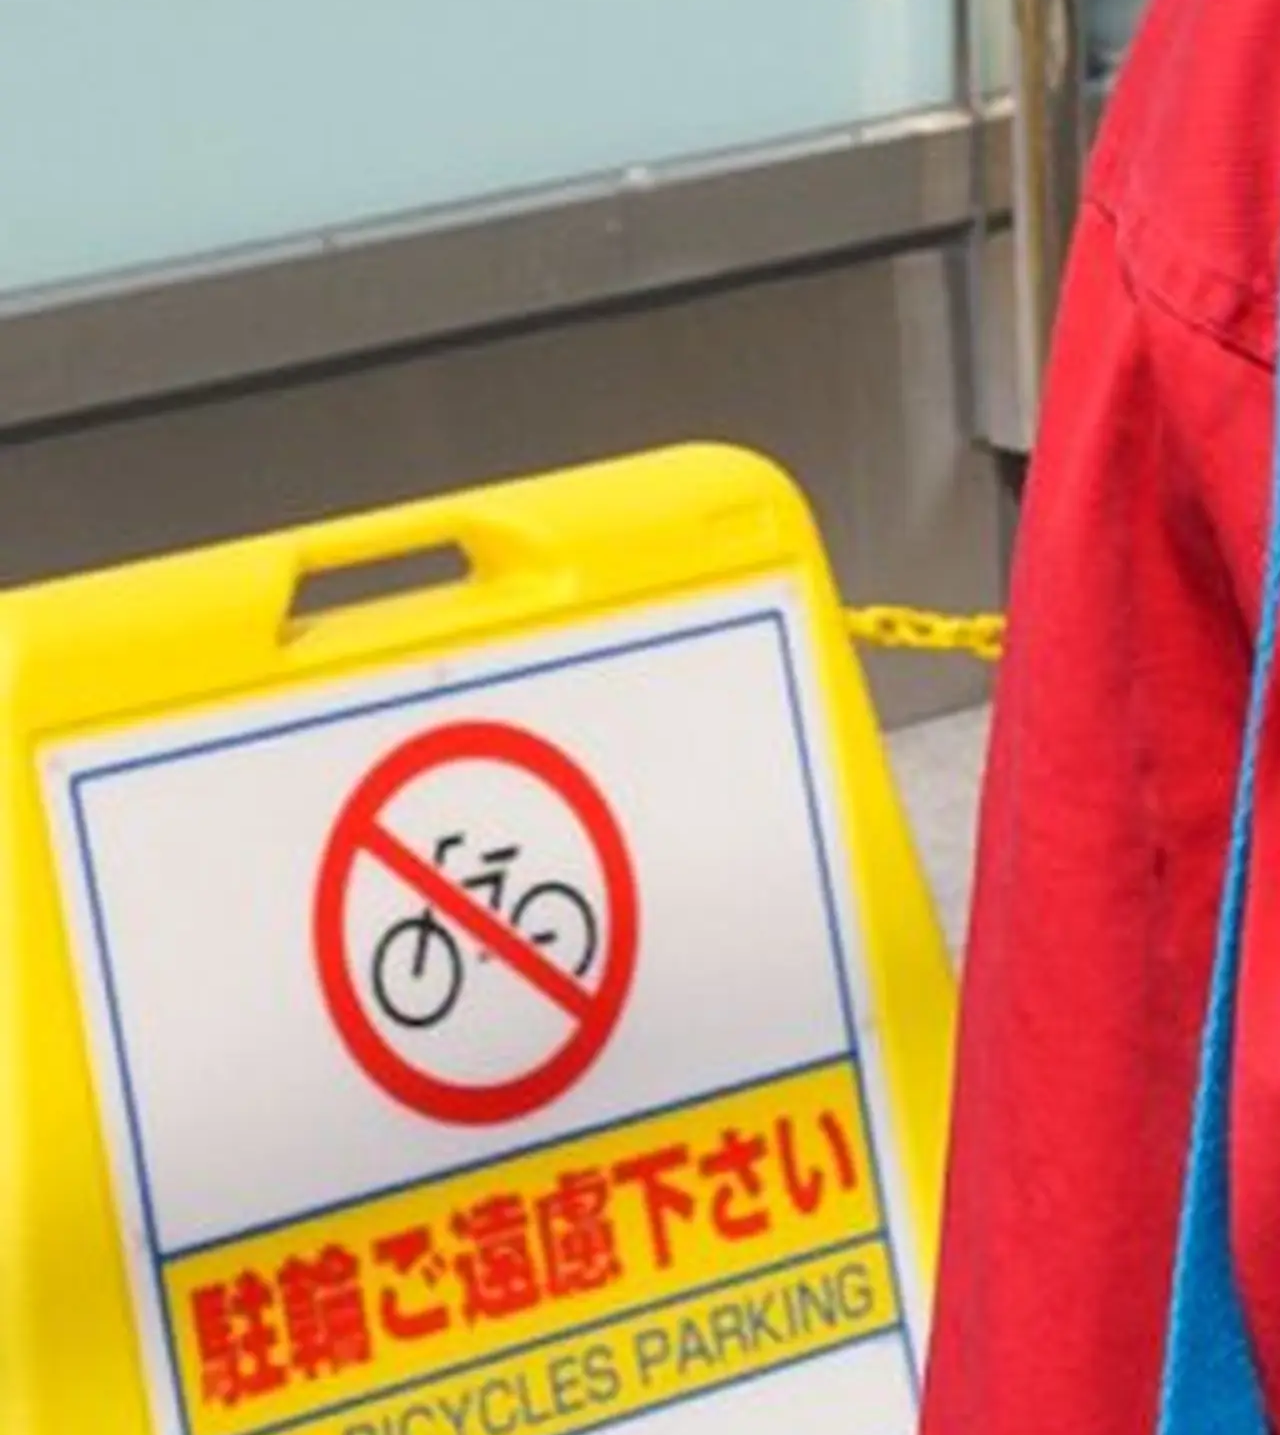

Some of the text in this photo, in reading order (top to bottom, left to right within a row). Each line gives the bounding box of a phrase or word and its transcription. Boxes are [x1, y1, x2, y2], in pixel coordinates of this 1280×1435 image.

[190, 1109, 859, 1406] 駐輪ご遠慮下さい
[637, 1262, 875, 1386] PARKING
